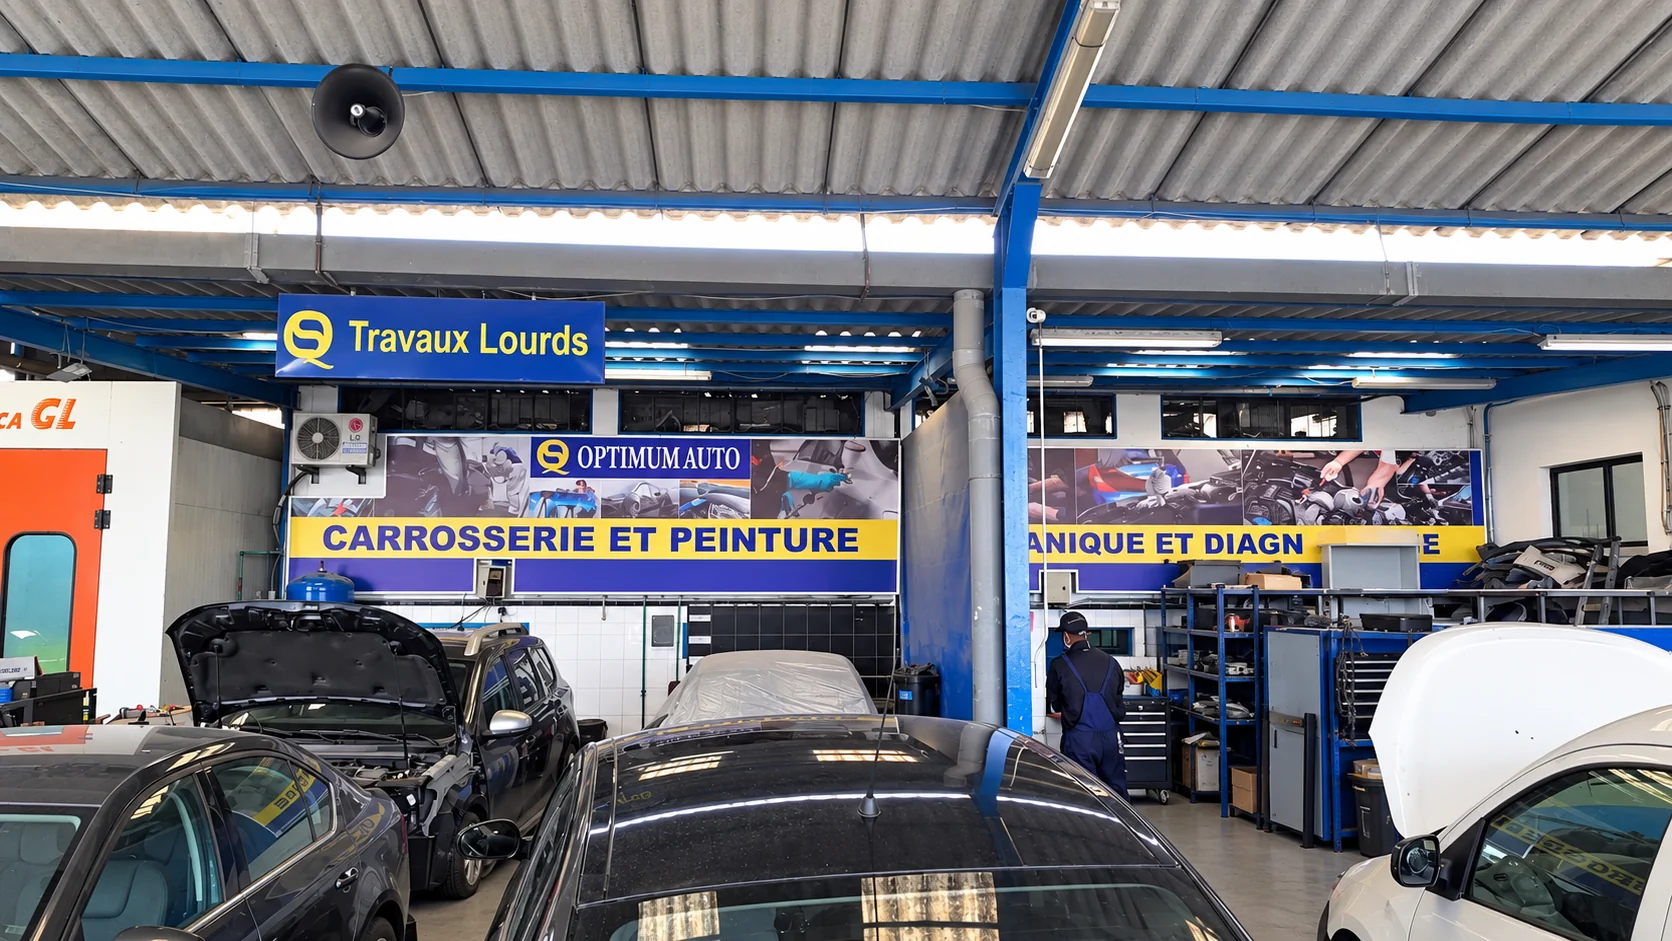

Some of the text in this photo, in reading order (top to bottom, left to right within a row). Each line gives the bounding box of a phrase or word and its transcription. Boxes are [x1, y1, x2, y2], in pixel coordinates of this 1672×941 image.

[349, 320, 469, 354] Travaux
[480, 322, 588, 356] Lourds
[31, 397, 77, 430] GL
[577, 445, 680, 470] OPTIMUM
[684, 446, 741, 470] AUTO
[323, 525, 859, 553] CARROSSERIE ET PEINTURE
[1156, 533, 1193, 555] ET
